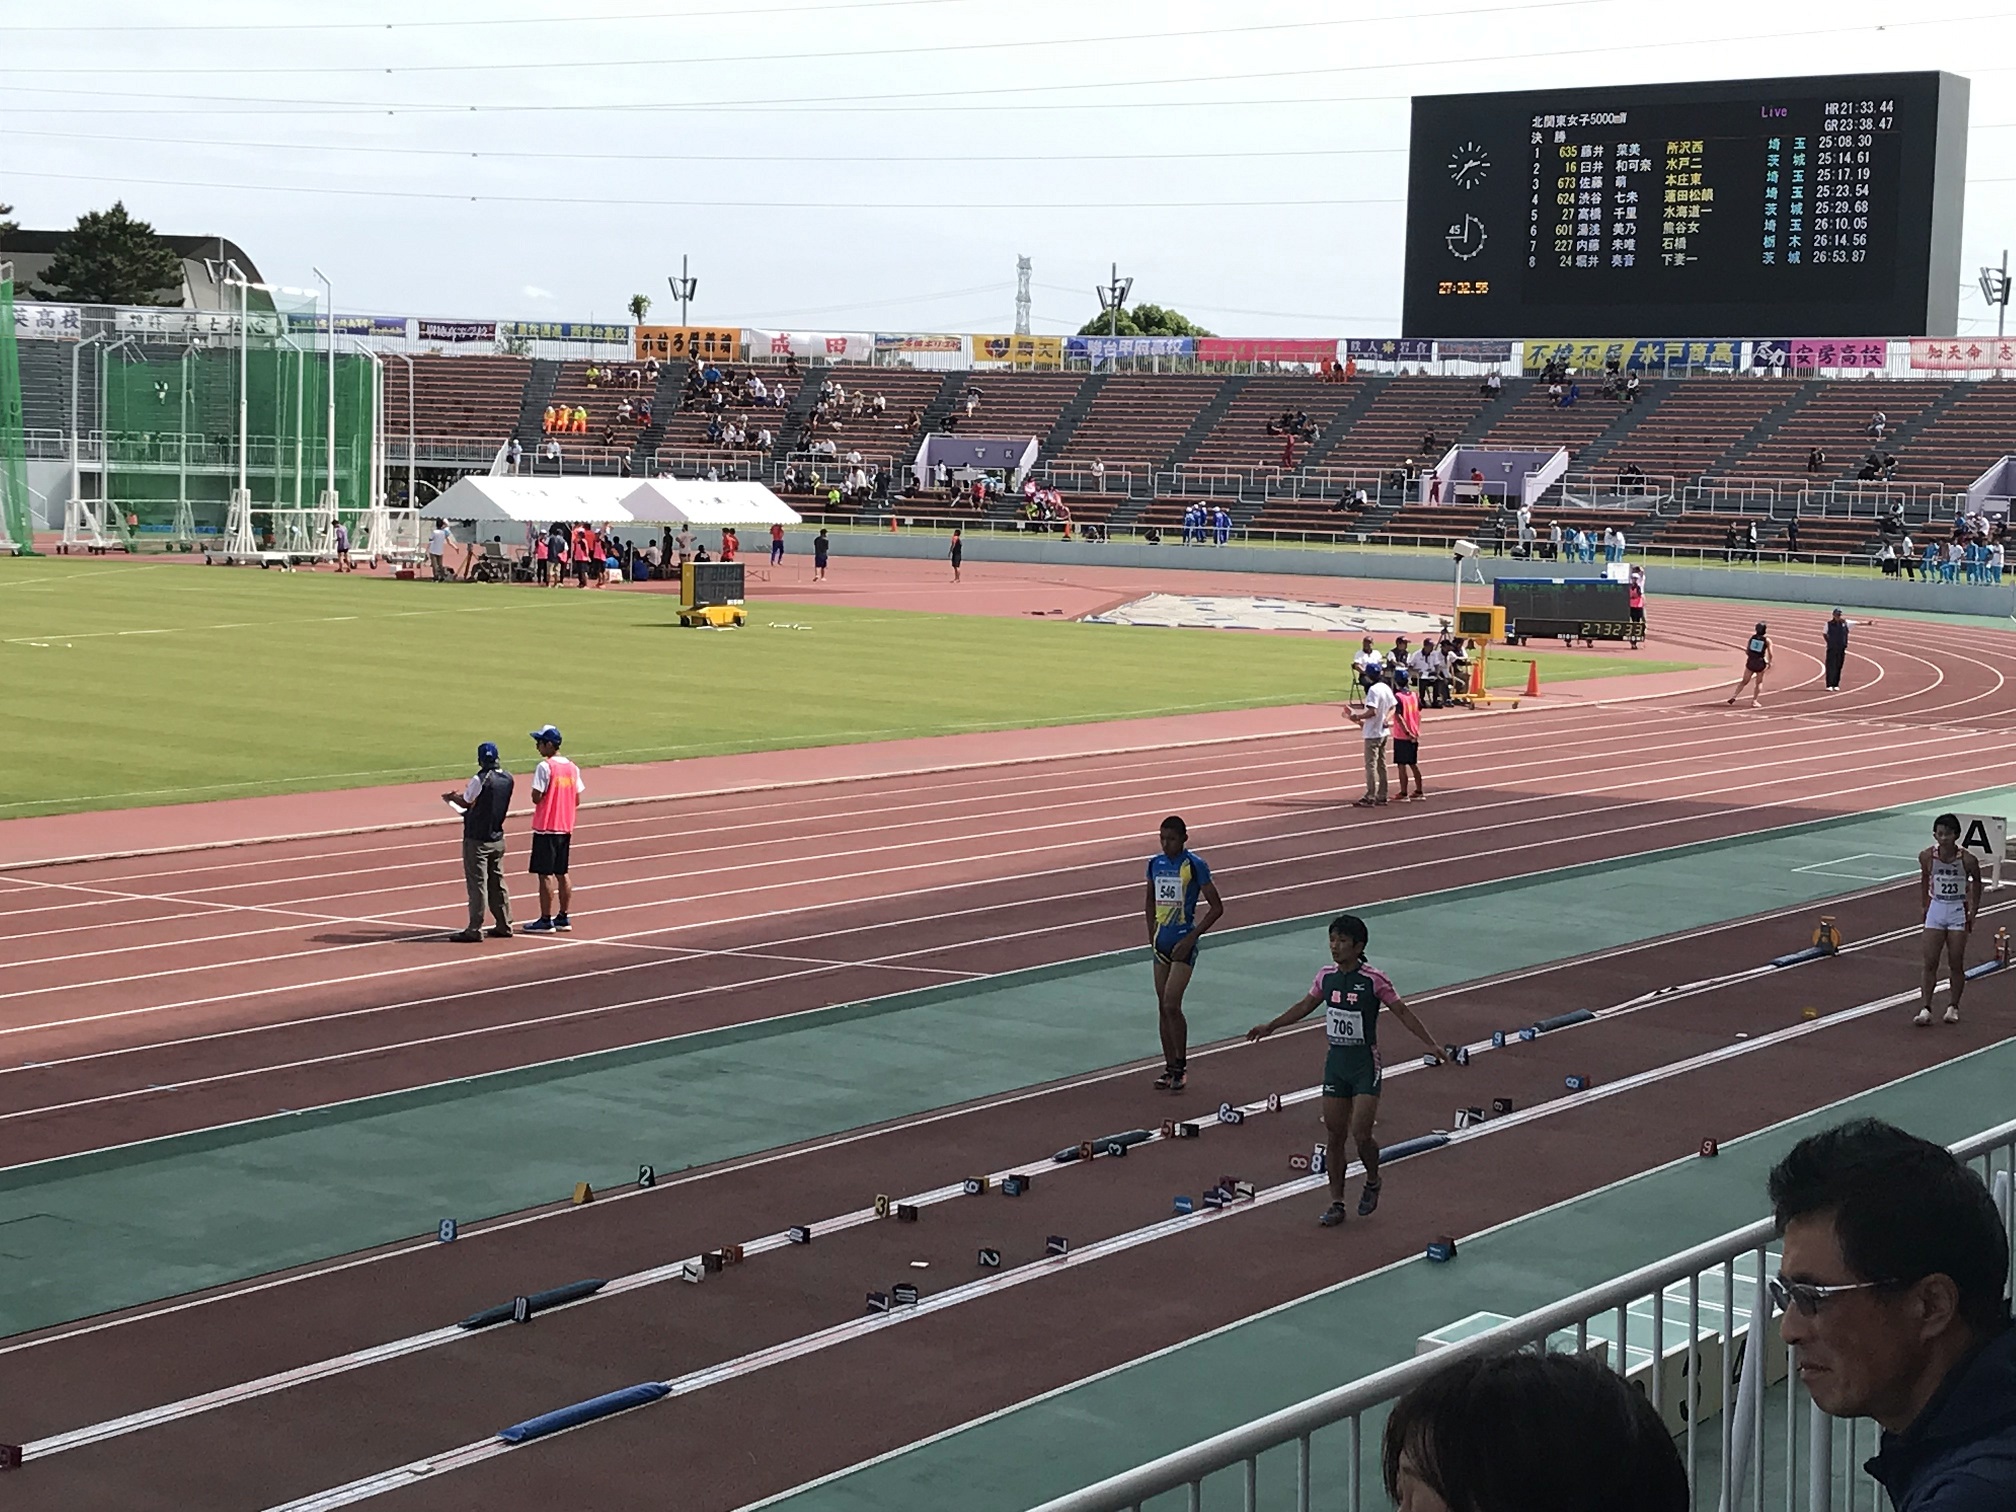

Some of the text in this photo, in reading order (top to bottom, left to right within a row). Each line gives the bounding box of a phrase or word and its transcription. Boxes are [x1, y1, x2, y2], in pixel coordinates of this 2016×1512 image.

[1761, 106, 1787, 117] Live
[1535, 148, 1539, 158] 1
[1560, 146, 1577, 158] 635
[1581, 145, 1604, 157] 藤井
[1666, 141, 1703, 154] 所沢西
[1819, 135, 1872, 148] 25:08.30
[1533, 163, 1540, 174] 2
[1565, 162, 1576, 173] 16
[1581, 161, 1604, 173] 臼井
[1616, 159, 1651, 172] 和可奈
[1666, 158, 1702, 170] 水戸二
[1818, 152, 1870, 165] 25:14.61
[1533, 179, 1539, 189] 3
[1558, 178, 1575, 189] 673
[1580, 177, 1602, 189] 佐藤
[1666, 174, 1702, 186] 本庄東
[1817, 168, 1870, 181] 25:17.19
[1532, 194, 1538, 205] 4
[1557, 193, 1574, 204] 624
[1816, 184, 1869, 197] 25:23.54
[1531, 210, 1537, 221] 5
[1562, 209, 1574, 220] 27
[1614, 207, 1637, 219] 千里
[1663, 205, 1712, 218] 水海道一
[1815, 201, 1868, 214] 25:29.68
[1530, 225, 1537, 236] 6
[1556, 224, 1572, 236] 601
[1577, 223, 1600, 236] 湯浅
[1663, 221, 1699, 234] 熊谷女
[1815, 217, 1867, 230] 26:10.05
[1530, 241, 1536, 251] 7
[1555, 239, 1572, 251] 227
[1576, 239, 1599, 251] 内藤
[1662, 237, 1686, 249] 石橋
[1814, 234, 1866, 246] 26:14.56
[1529, 256, 1536, 267] 8
[1560, 255, 1571, 266] 24
[1662, 253, 1698, 266] 下妻一
[1813, 250, 1866, 263] 26:53.87
[771, 333, 847, 354] 成田
[1087, 340, 1183, 357] 駿台甲府高校
[1796, 344, 1882, 366] 安房高校
[1928, 344, 1982, 361] 知天命
[1962, 820, 1992, 854] A
[1160, 885, 1176, 899] 546
[1941, 883, 1958, 894] 223
[1333, 1019, 1353, 1036] 706
[1566, 1077, 1579, 1088] 8
[1269, 1093, 1277, 1111] 8
[1457, 1110, 1467, 1125] 7
[1703, 1141, 1712, 1153] 9
[1290, 1156, 1307, 1169] 8
[1311, 1154, 1322, 1171] 8
[640, 1166, 651, 1186] 2
[875, 1196, 886, 1216] 3
[440, 1220, 453, 1240] 8
[980, 1251, 999, 1266] 2
[515, 1298, 526, 1320] 10
